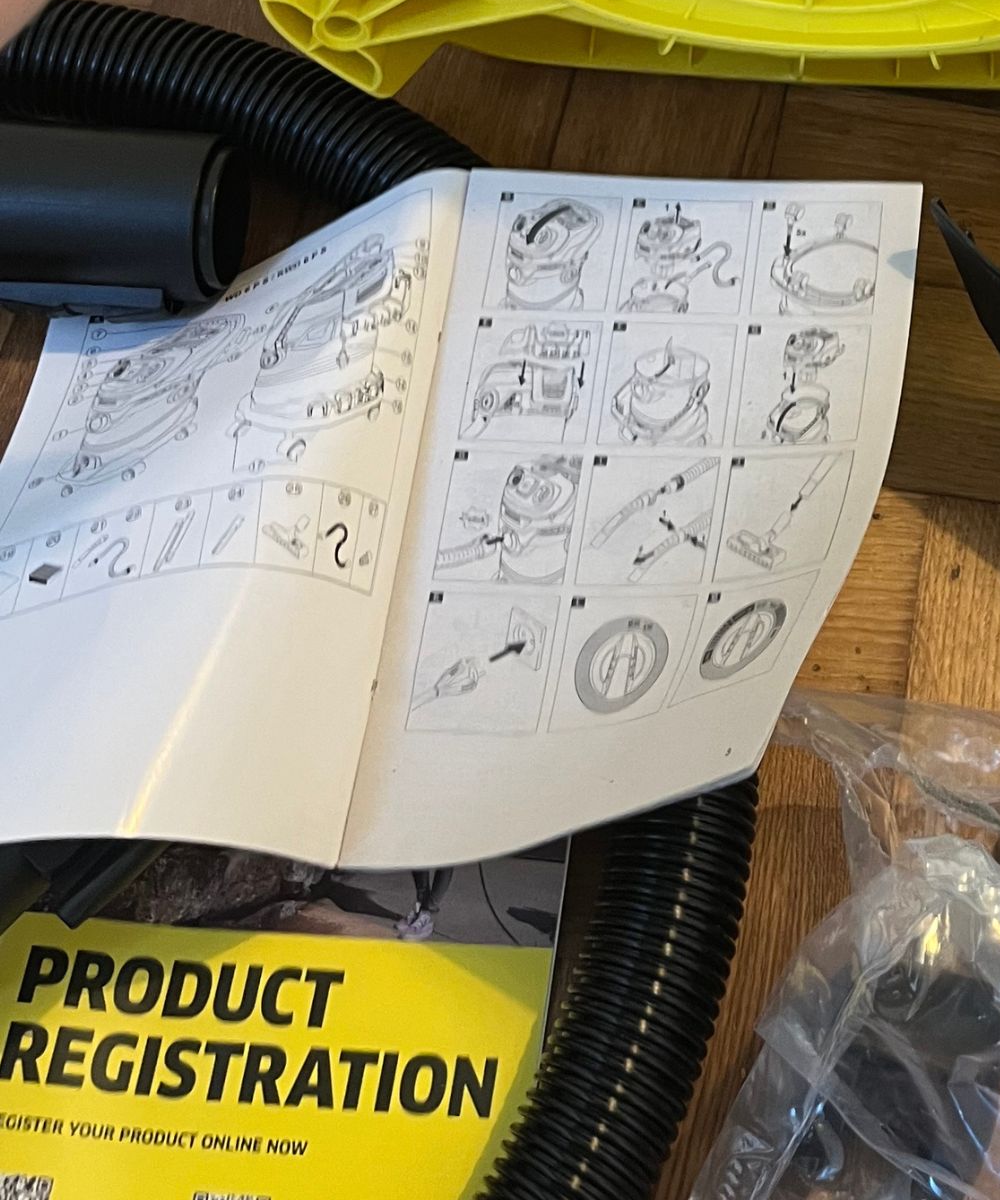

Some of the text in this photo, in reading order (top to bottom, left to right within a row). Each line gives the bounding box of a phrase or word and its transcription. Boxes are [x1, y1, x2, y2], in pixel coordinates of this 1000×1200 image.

[16, 945, 346, 1029] PRODUCT
[0, 1021, 499, 1119] REGISTRATION
[69, 1122, 115, 1142] YOUR
[118, 1126, 199, 1150] PRODUCT
[201, 1133, 263, 1155] ONLINE
[266, 1139, 309, 1157] NOW
